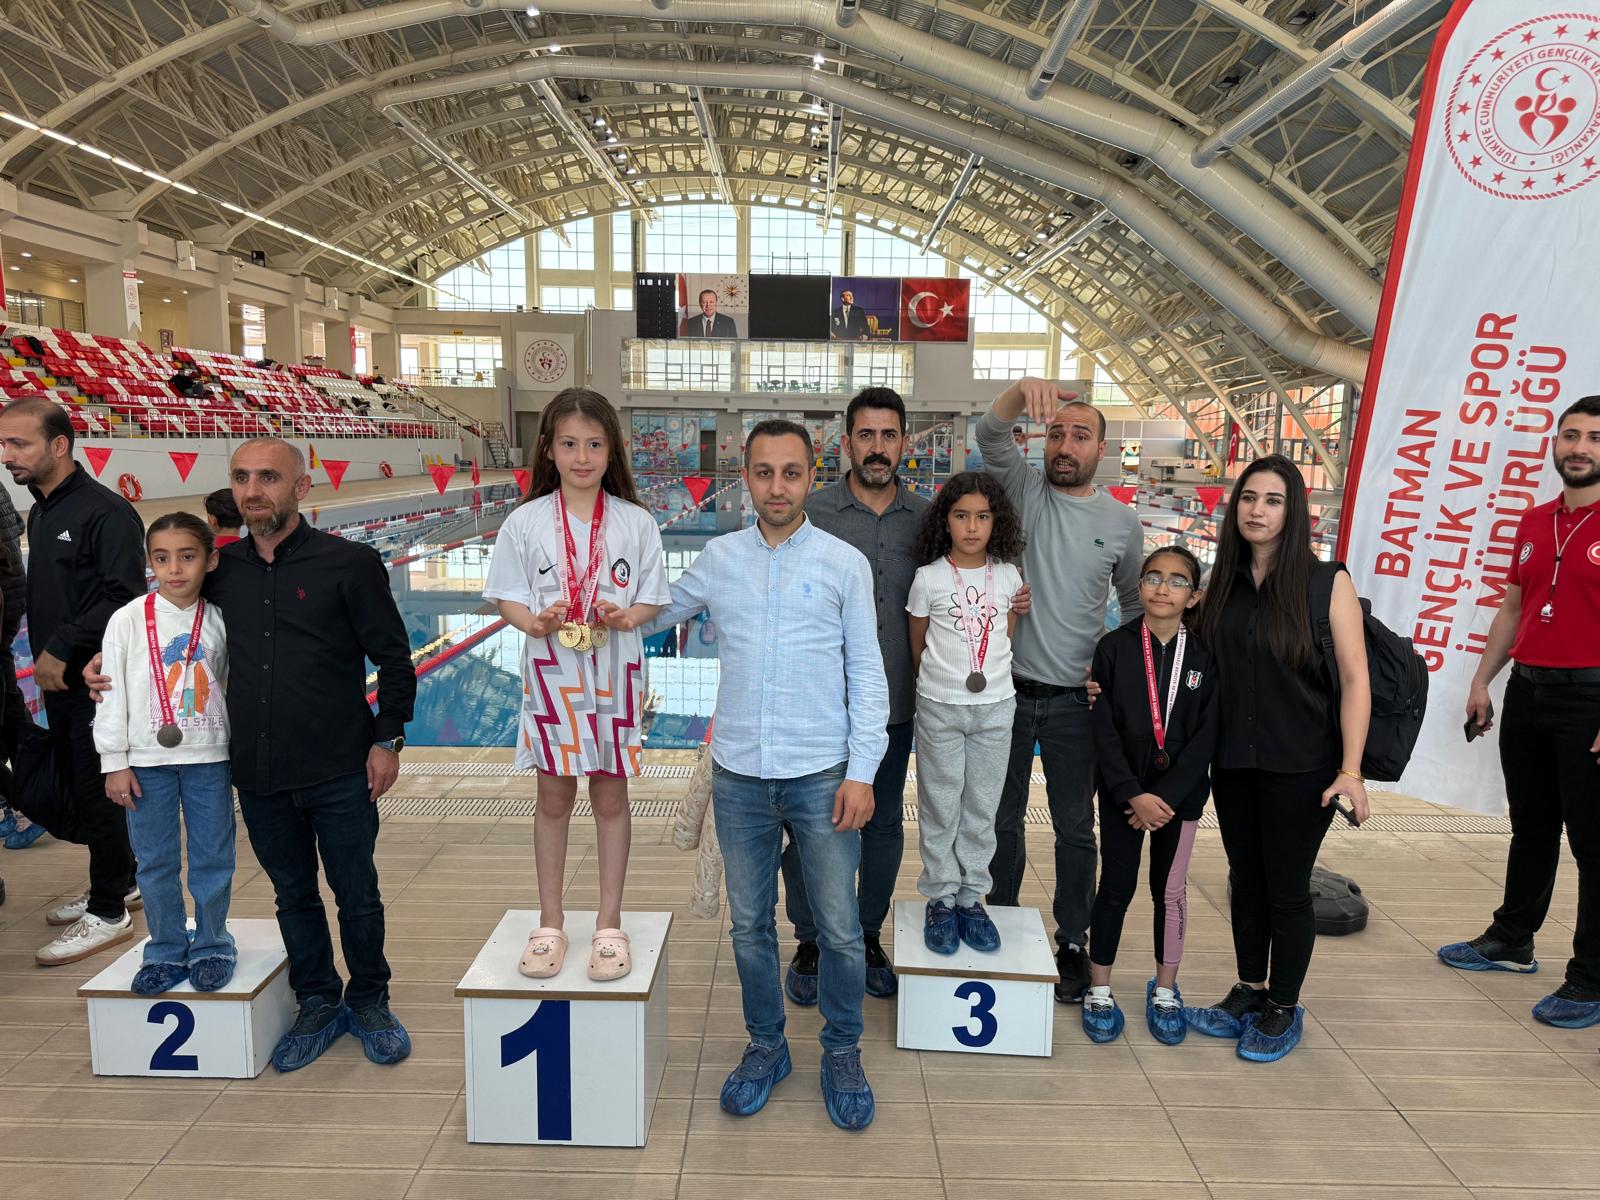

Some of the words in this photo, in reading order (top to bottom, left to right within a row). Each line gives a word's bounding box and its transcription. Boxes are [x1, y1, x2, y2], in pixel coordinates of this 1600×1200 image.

[1480, 52, 1534, 126] CUMHURİYETİ
[1537, 48, 1592, 66] GENÇLİK
[1480, 127, 1518, 165] TÜRKİYE
[1459, 313, 1518, 427] SPOR
[1374, 409, 1441, 578] BATMAN
[1444, 439, 1491, 491] VE
[1413, 504, 1477, 673] GENÇLİK
[146, 1001, 199, 1072] 2
[952, 981, 998, 1047] 3
[500, 1000, 572, 1141] 1
